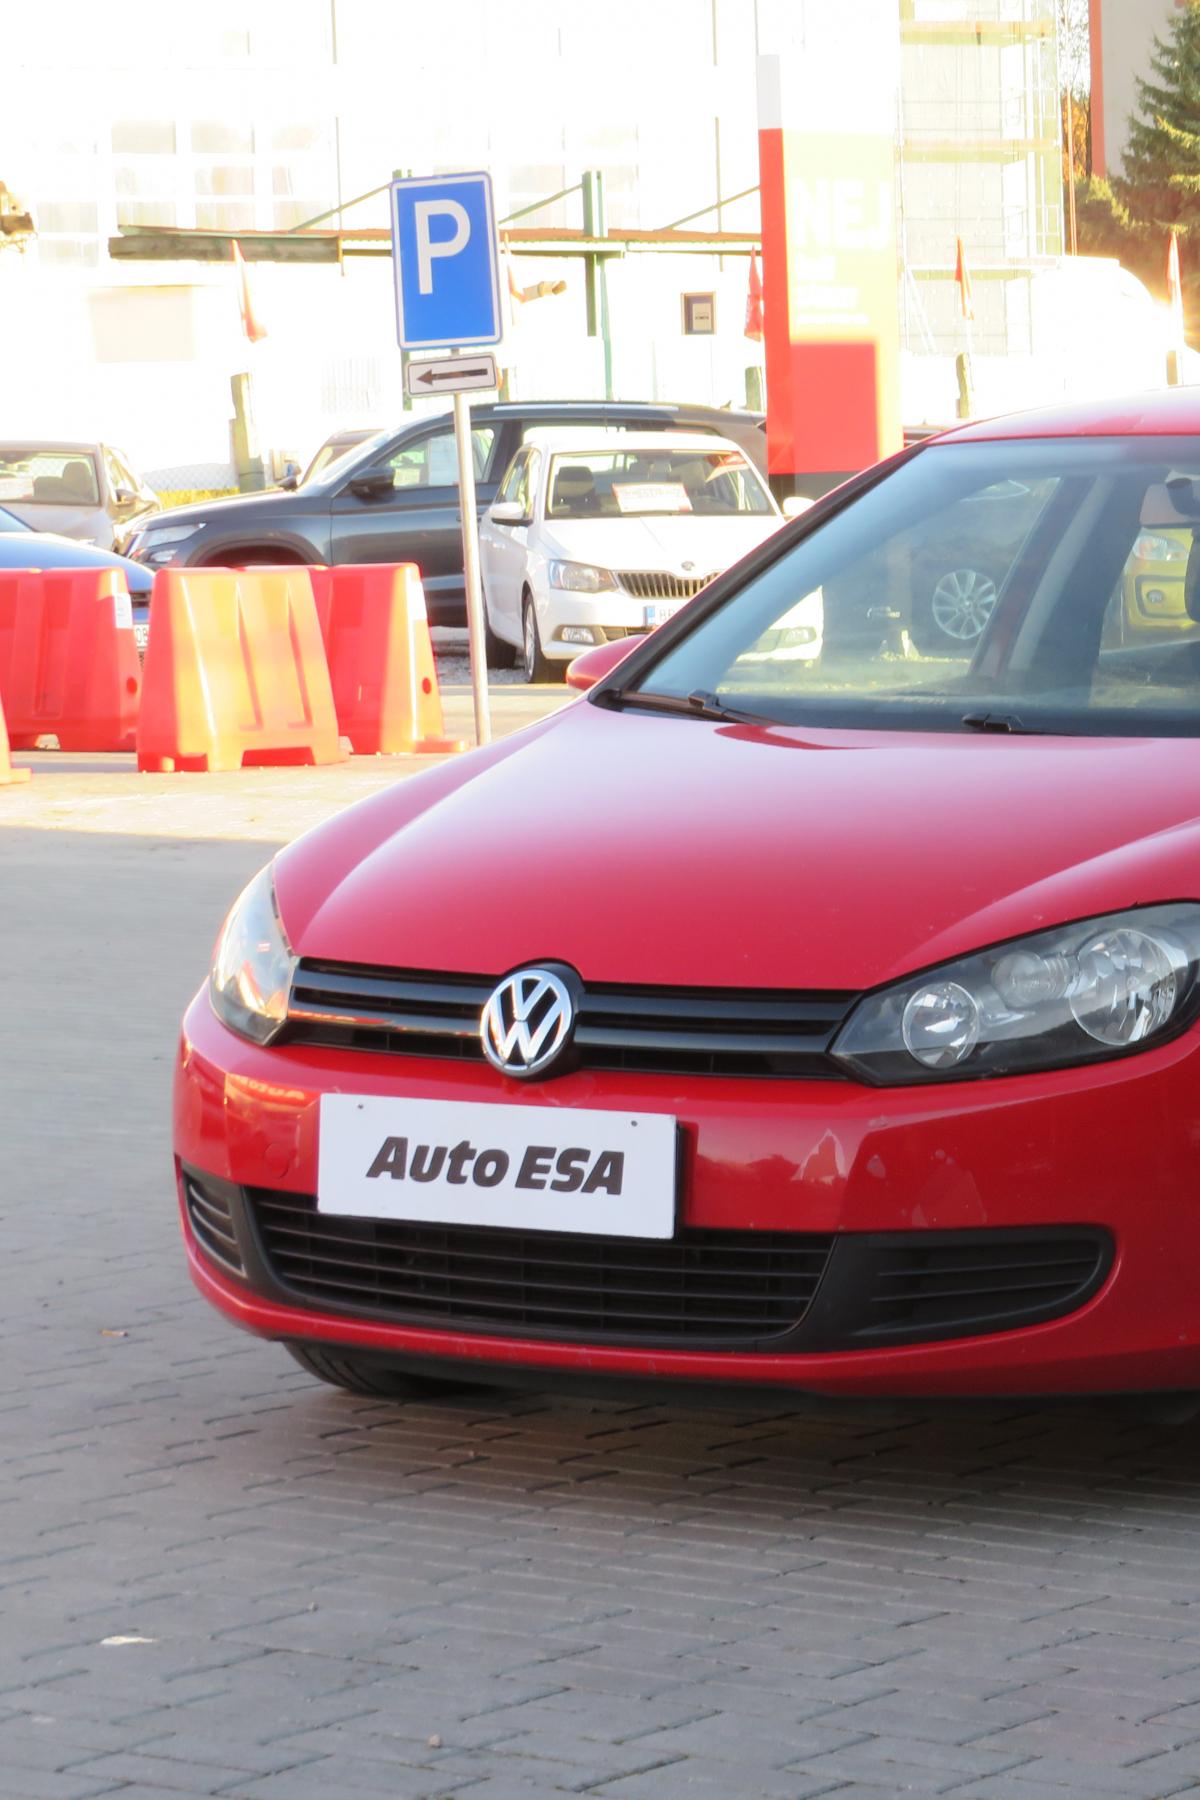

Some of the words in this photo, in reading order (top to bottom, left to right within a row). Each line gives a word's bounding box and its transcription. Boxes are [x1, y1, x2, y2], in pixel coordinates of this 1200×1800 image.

[413, 199, 471, 295] P
[366, 1136, 510, 1188] Auto
[514, 1145, 625, 1195] ESA
